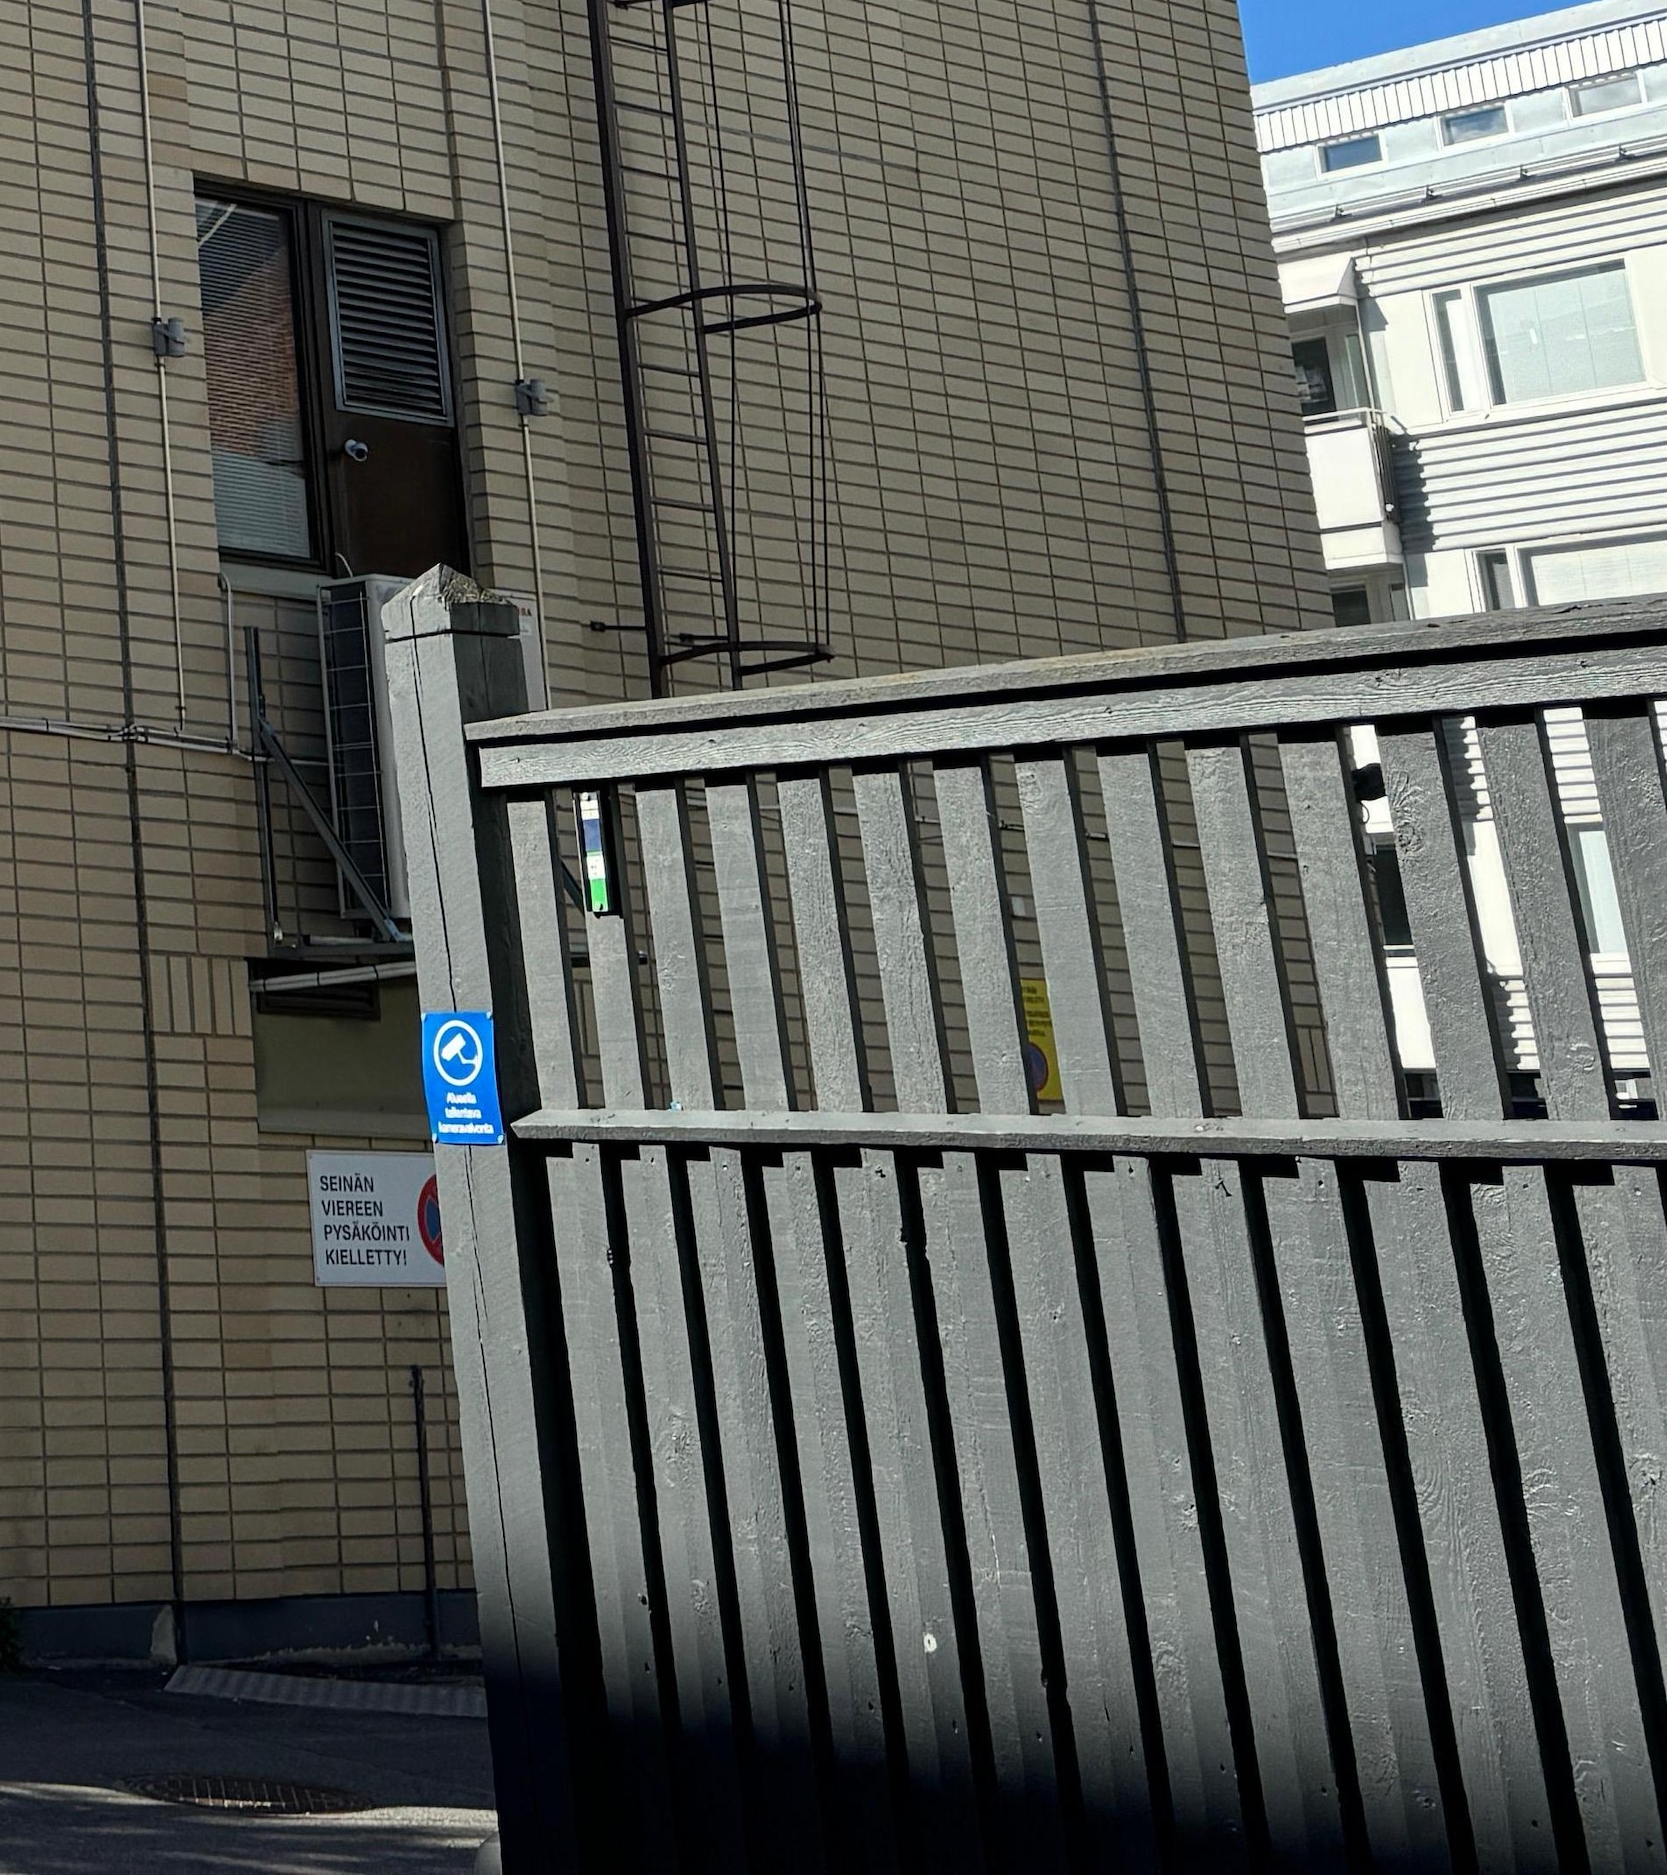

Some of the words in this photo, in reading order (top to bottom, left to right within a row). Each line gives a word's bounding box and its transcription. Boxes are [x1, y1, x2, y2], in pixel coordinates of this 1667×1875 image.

[319, 1173, 375, 1193] SEINÄN
[321, 1199, 384, 1217] VIEREEN
[323, 1220, 410, 1242] PYSÄKÖINTI
[325, 1248, 407, 1266] KIELLETTY!
